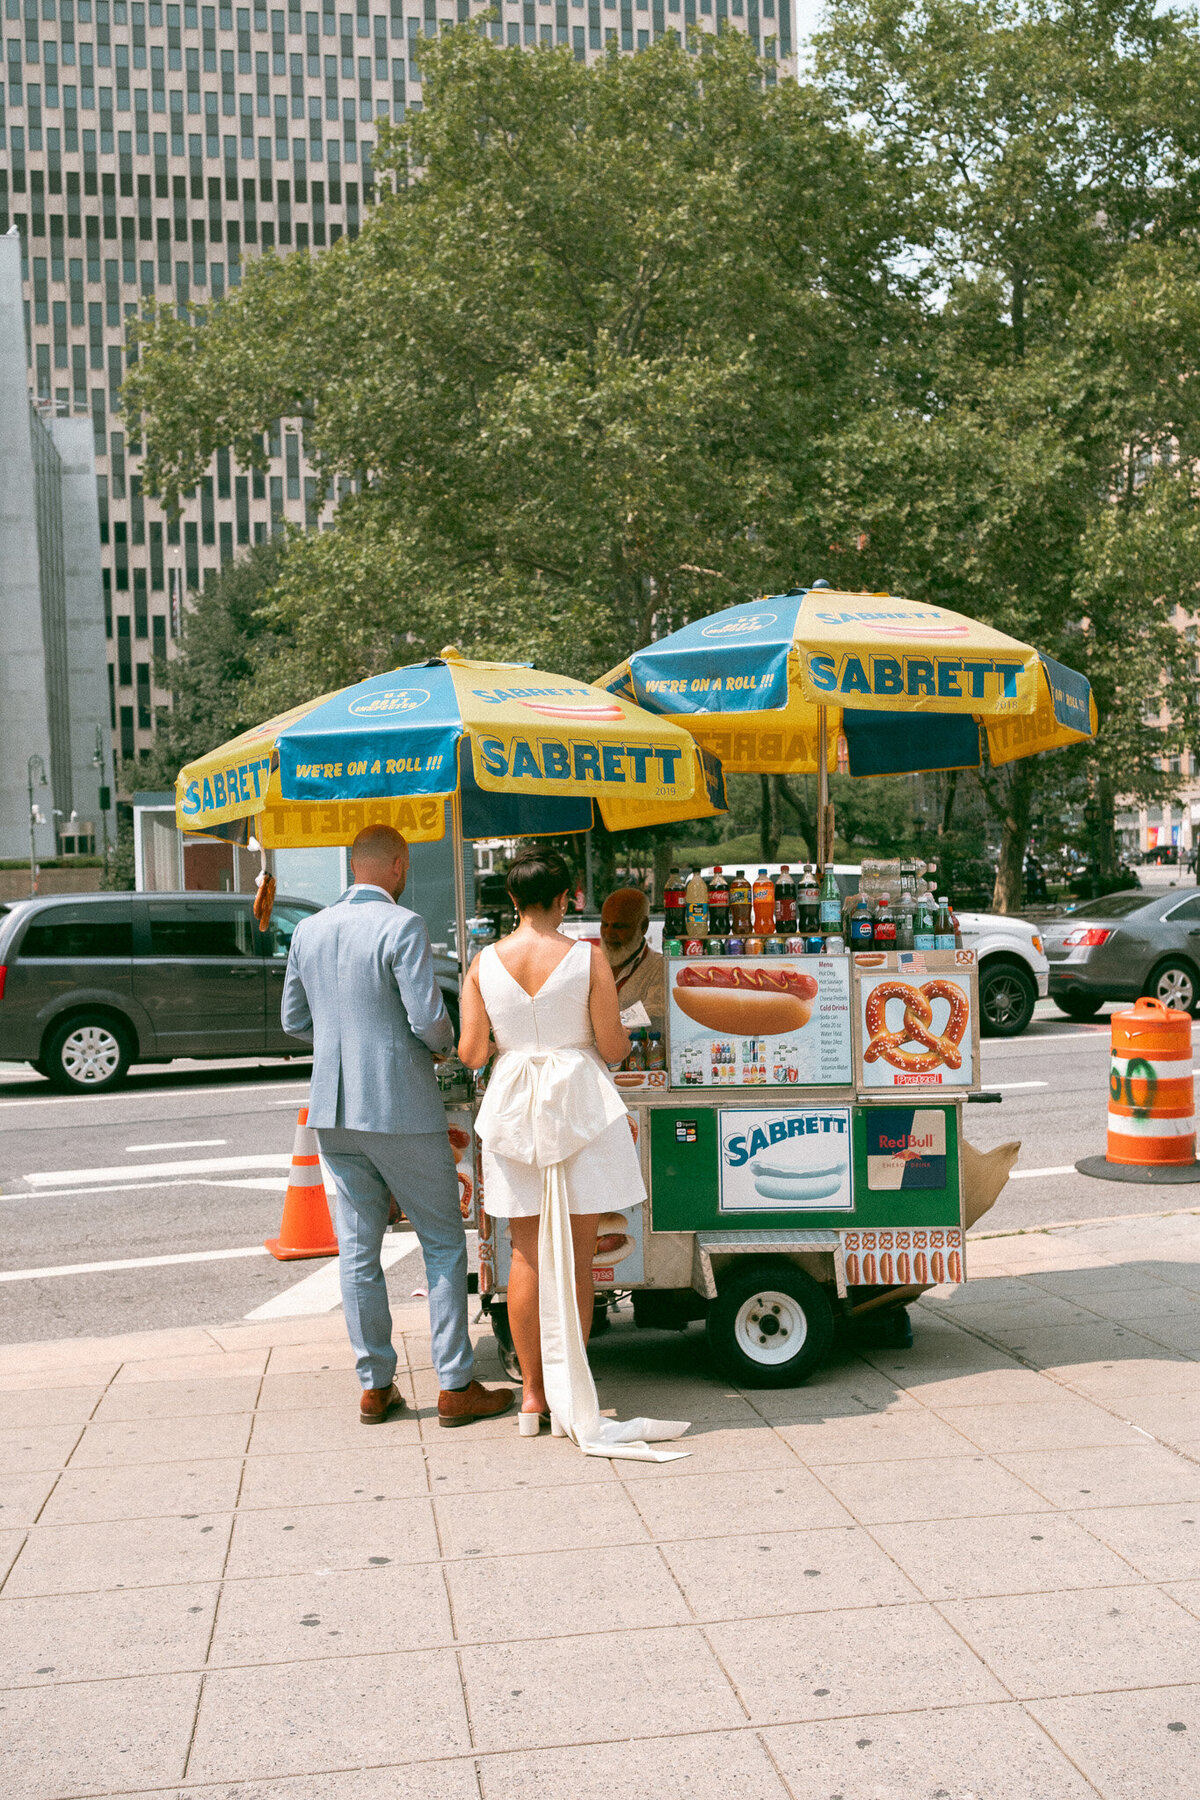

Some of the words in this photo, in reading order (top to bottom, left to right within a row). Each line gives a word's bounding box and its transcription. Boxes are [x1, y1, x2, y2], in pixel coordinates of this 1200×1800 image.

[815, 612, 942, 625] SABRETT
[806, 651, 1025, 699] SABRETT
[645, 679, 687, 694] WE'RE
[691, 679, 709, 693] ON
[712, 678, 722, 691] A
[725, 676, 756, 691] ROLL
[472, 688, 591, 704] SABRETT
[995, 701, 1018, 711] 2018
[477, 734, 682, 785] SABRETT
[296, 760, 343, 779] WE'RE
[347, 761, 367, 776] ON
[371, 761, 381, 775] A
[386, 757, 422, 774] ROLL
[656, 786, 676, 796] 2019
[897, 1074, 939, 1086] Pretzel
[723, 1113, 847, 1167] SABRETT
[879, 1134, 906, 1148] Red
[907, 1134, 933, 1148] Bull
